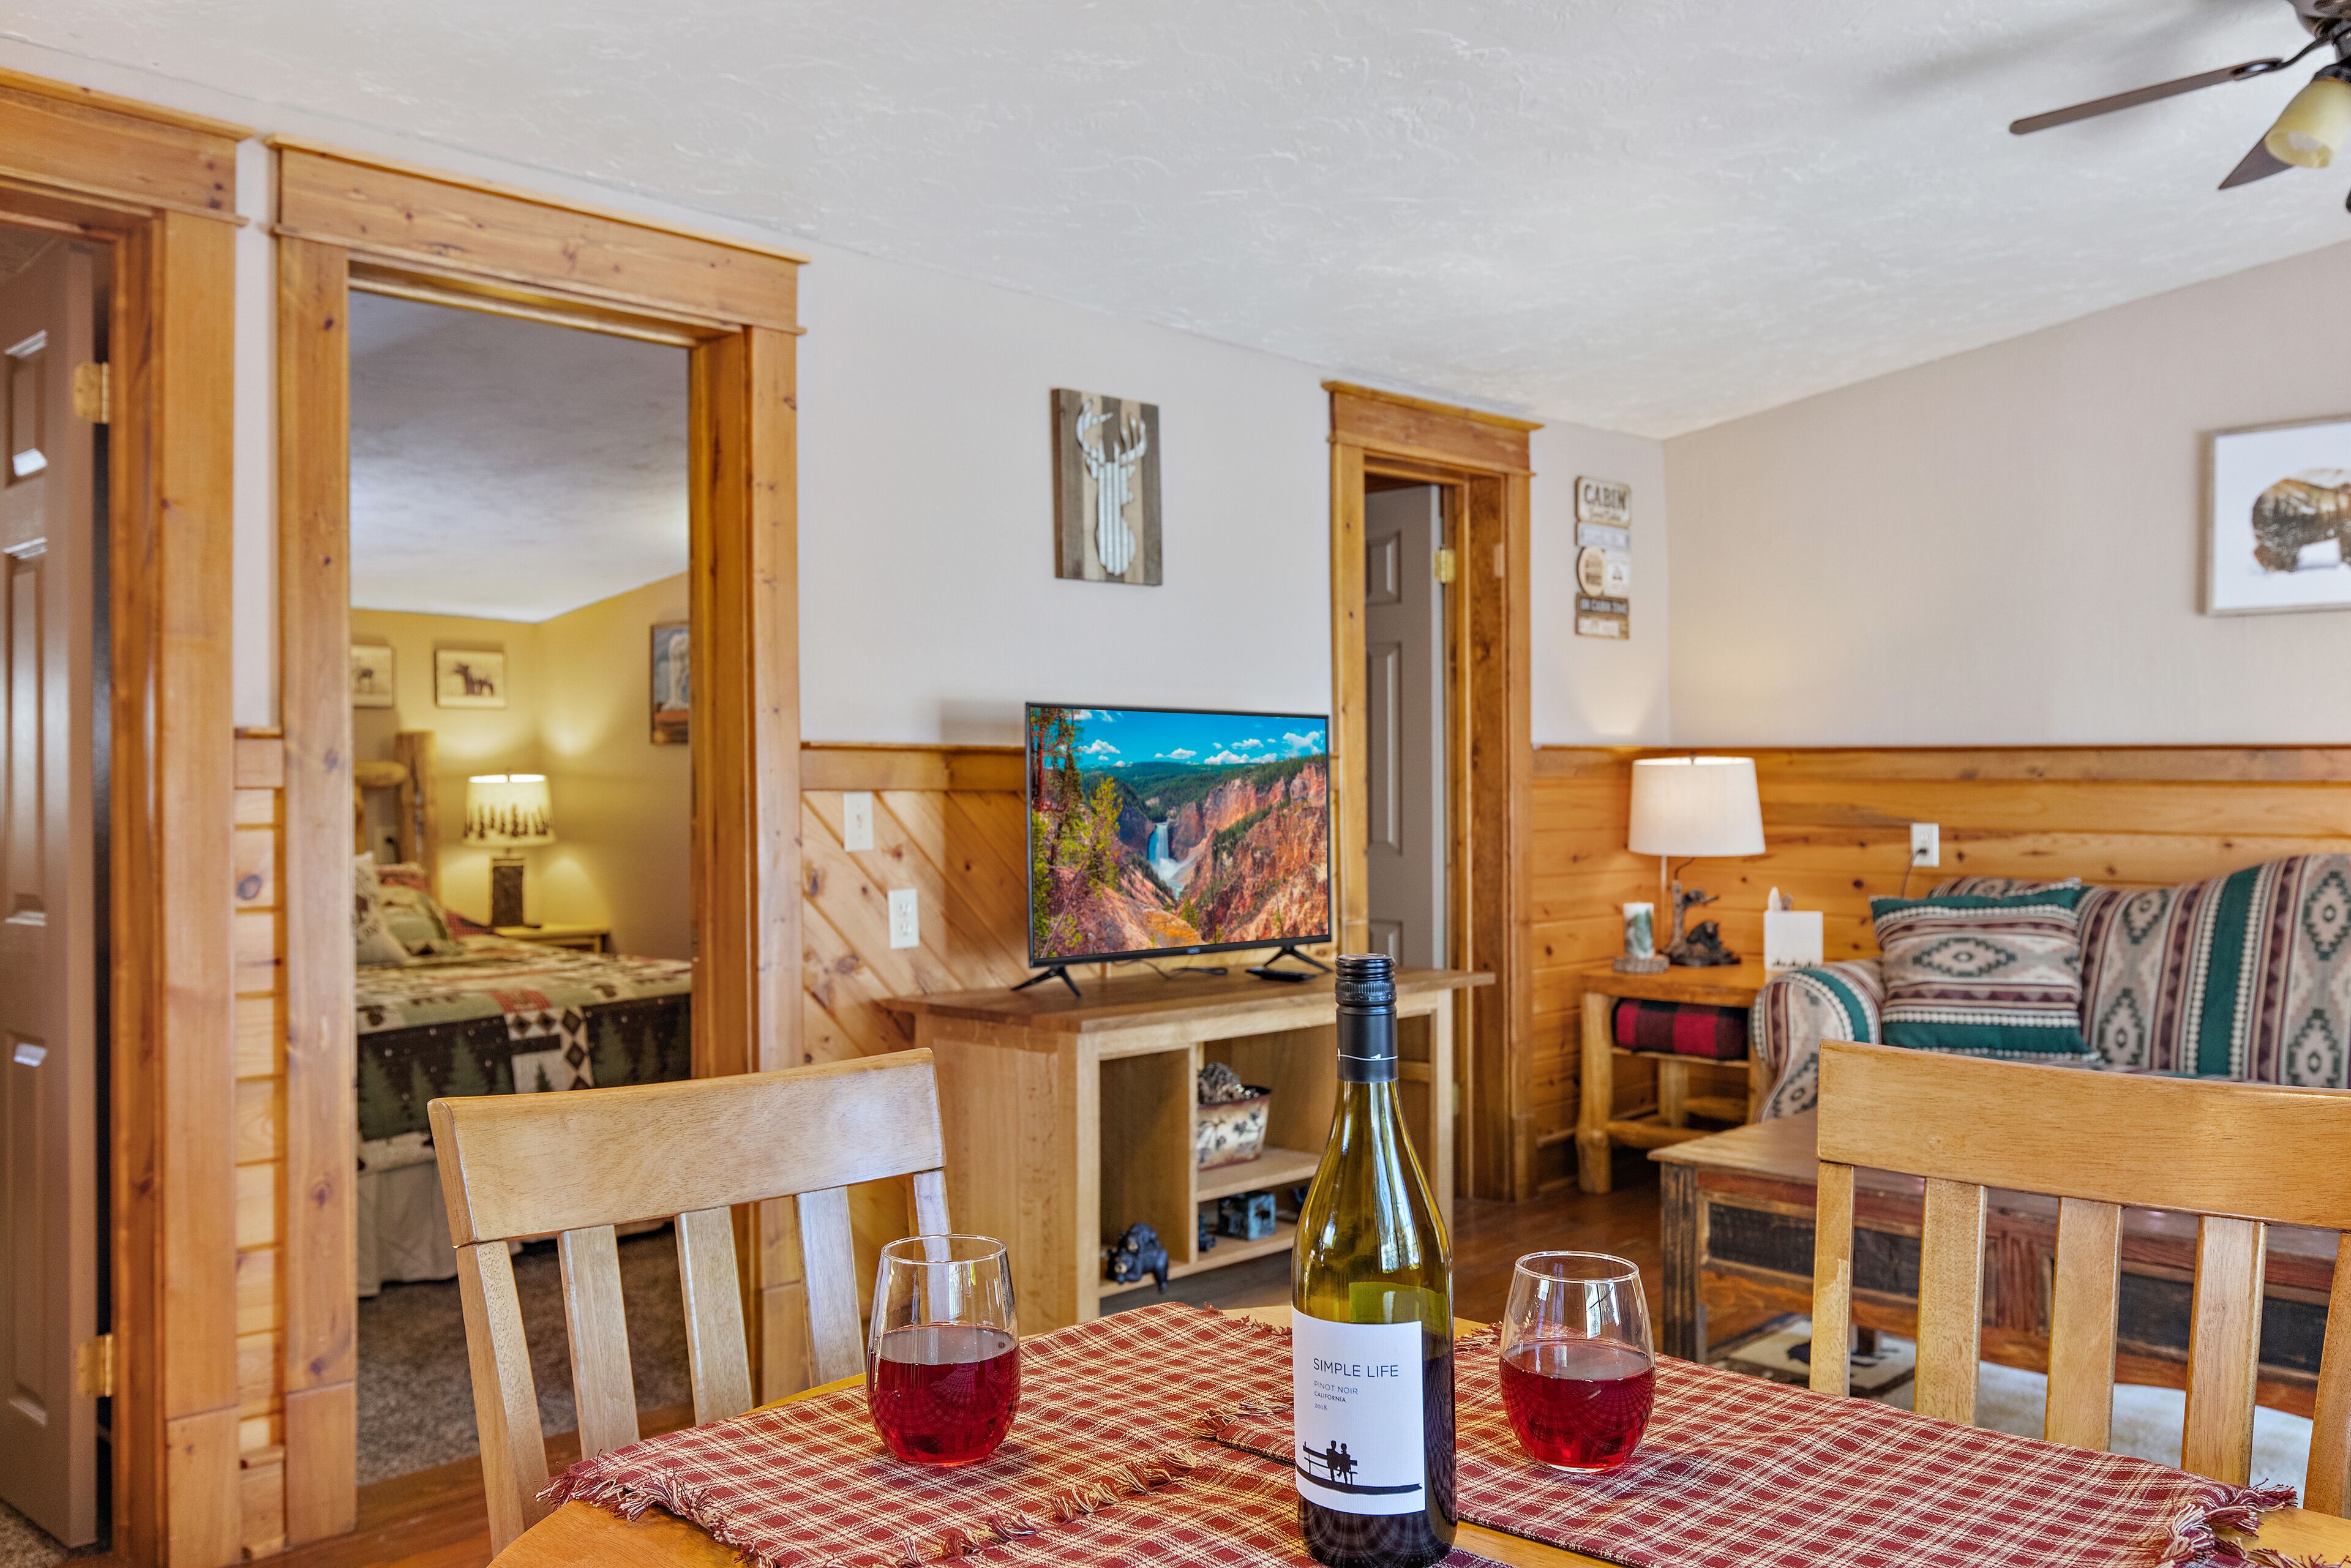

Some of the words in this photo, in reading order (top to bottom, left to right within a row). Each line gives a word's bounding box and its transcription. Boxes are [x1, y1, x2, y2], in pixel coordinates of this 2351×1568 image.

[1584, 484, 1627, 510] CABIN
[1313, 1358, 1361, 1377] SIMPLE
[1367, 1365, 1398, 1378] LIFE
[1314, 1381, 1335, 1392] PINOT
[1337, 1386, 1358, 1395] NOIR
[1314, 1391, 1346, 1403] CALIFORNIA
